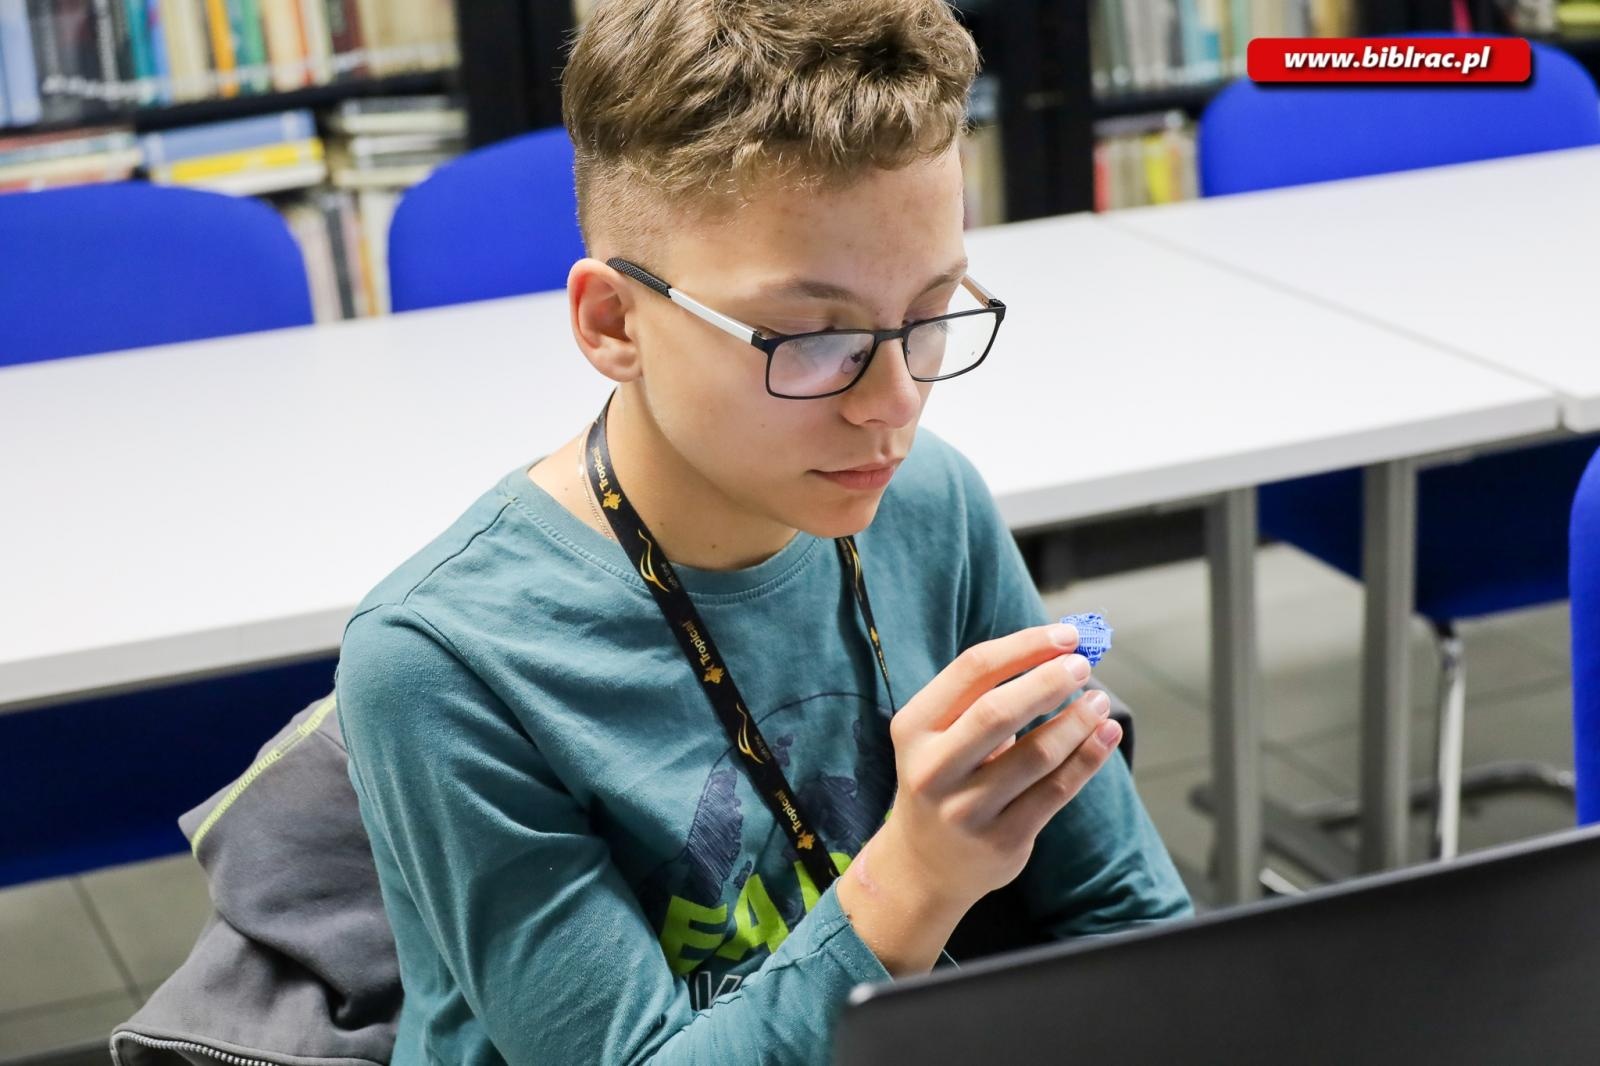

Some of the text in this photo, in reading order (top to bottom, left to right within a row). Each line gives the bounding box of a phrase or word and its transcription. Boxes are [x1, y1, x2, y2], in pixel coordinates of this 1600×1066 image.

[591, 446, 609, 491] Tropical
[682, 621, 711, 666] Tropical
[775, 789, 803, 833] Tropical
